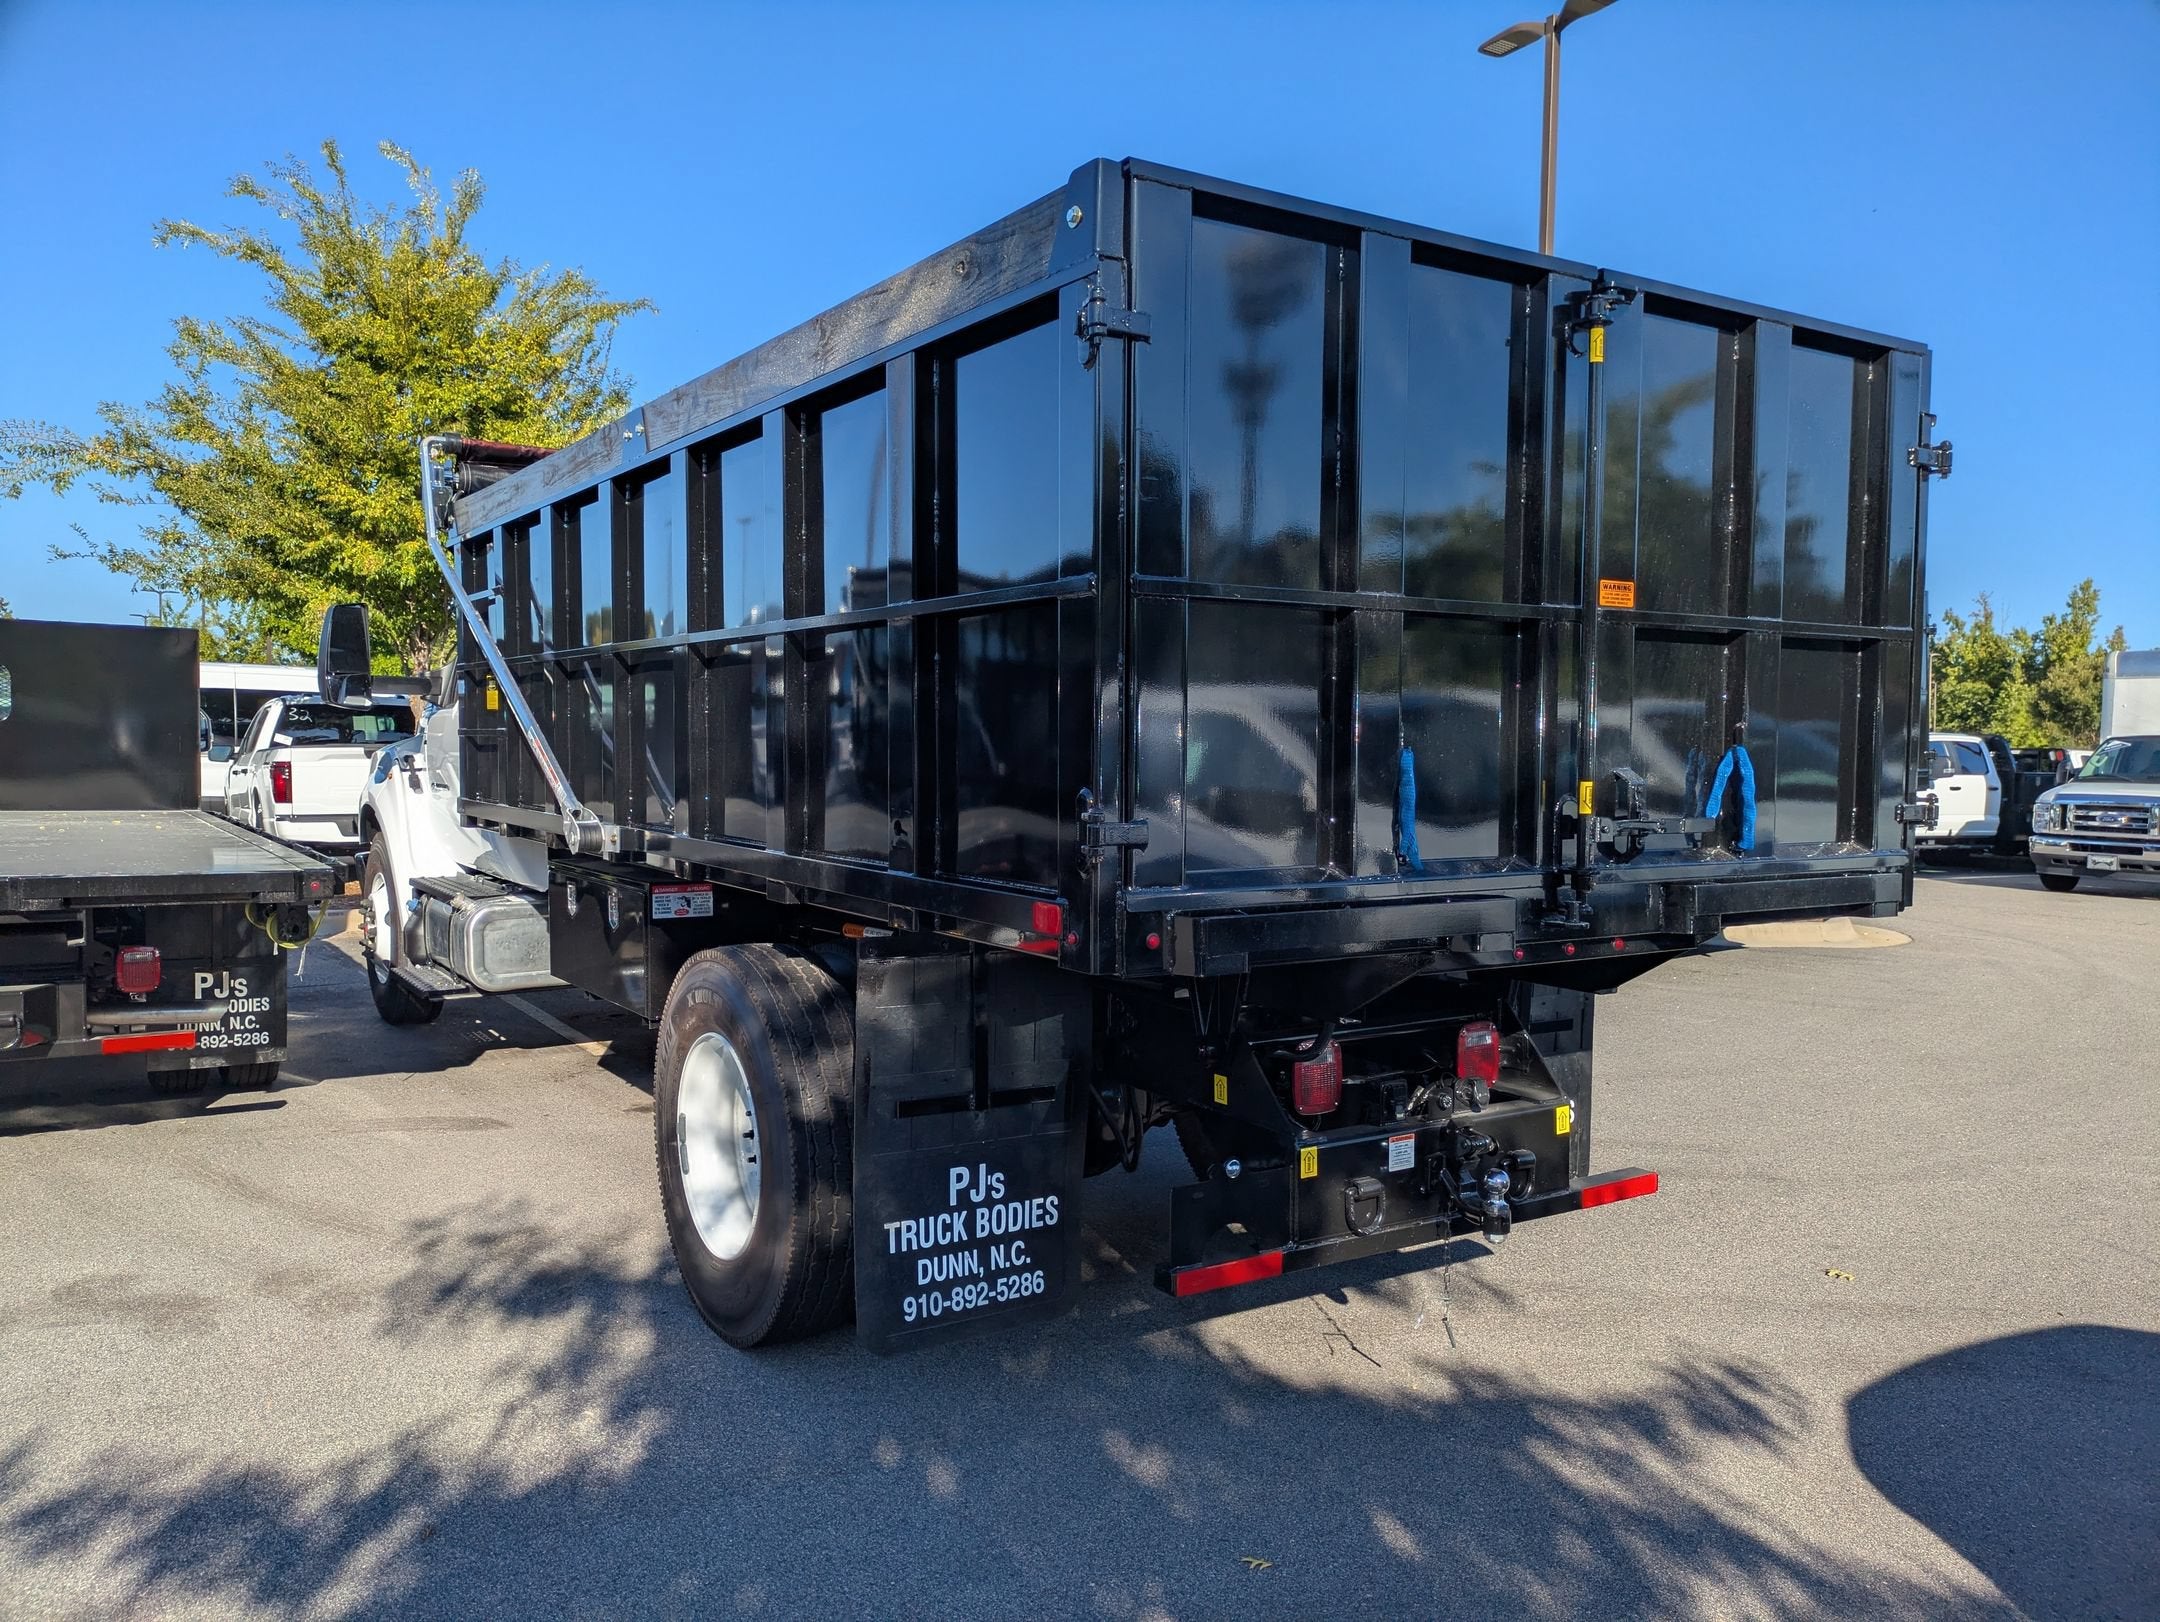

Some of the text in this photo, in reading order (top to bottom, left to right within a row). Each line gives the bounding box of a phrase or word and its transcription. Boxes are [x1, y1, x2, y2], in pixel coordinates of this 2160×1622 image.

[1602, 583, 1632, 591] WARNING
[289, 707, 313, 723] 32
[228, 997, 270, 1014] ODIES
[229, 1014, 260, 1030] N.C.
[167, 1031, 270, 1051] -892-5286
[884, 1195, 1059, 1254] TRUCK BODIES
[917, 1240, 1031, 1286] DUNN, N.C.
[903, 1270, 1045, 1322] 910-892-5286
